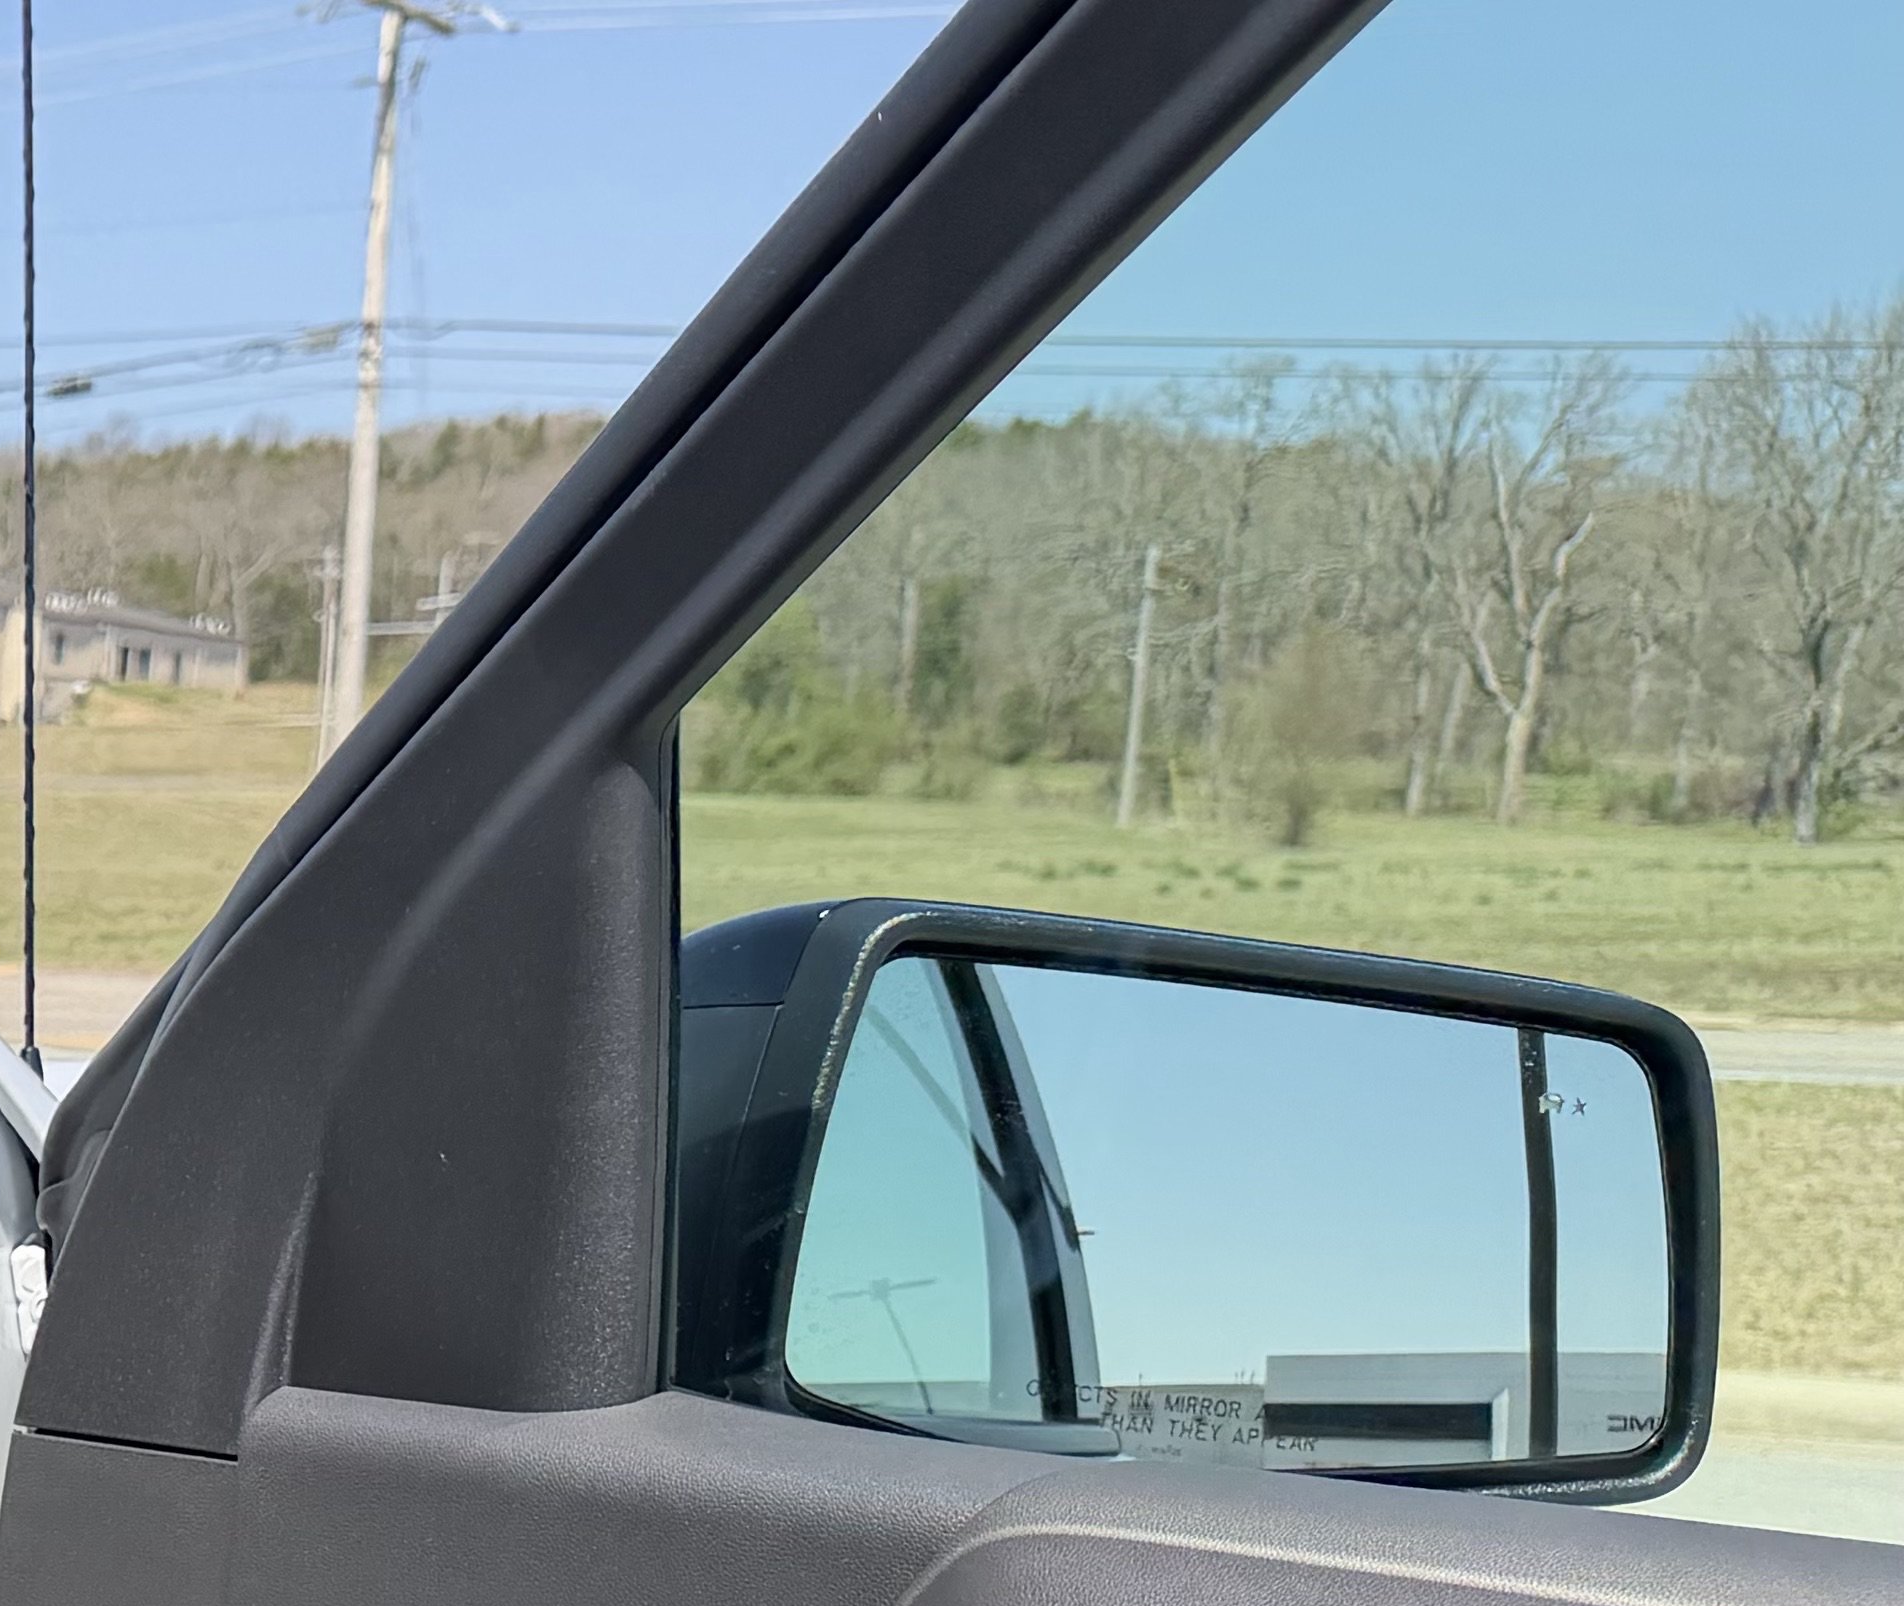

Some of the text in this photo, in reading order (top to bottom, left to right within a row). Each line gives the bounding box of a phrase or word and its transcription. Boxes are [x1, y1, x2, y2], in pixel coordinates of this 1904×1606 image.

[1026, 1379, 1118, 1406] OCTS
[1131, 1390, 1152, 1409] IN
[1164, 1394, 1242, 1419] MIRROR
[1100, 1411, 1154, 1434] THAN
[1169, 1419, 1225, 1442] THEY
